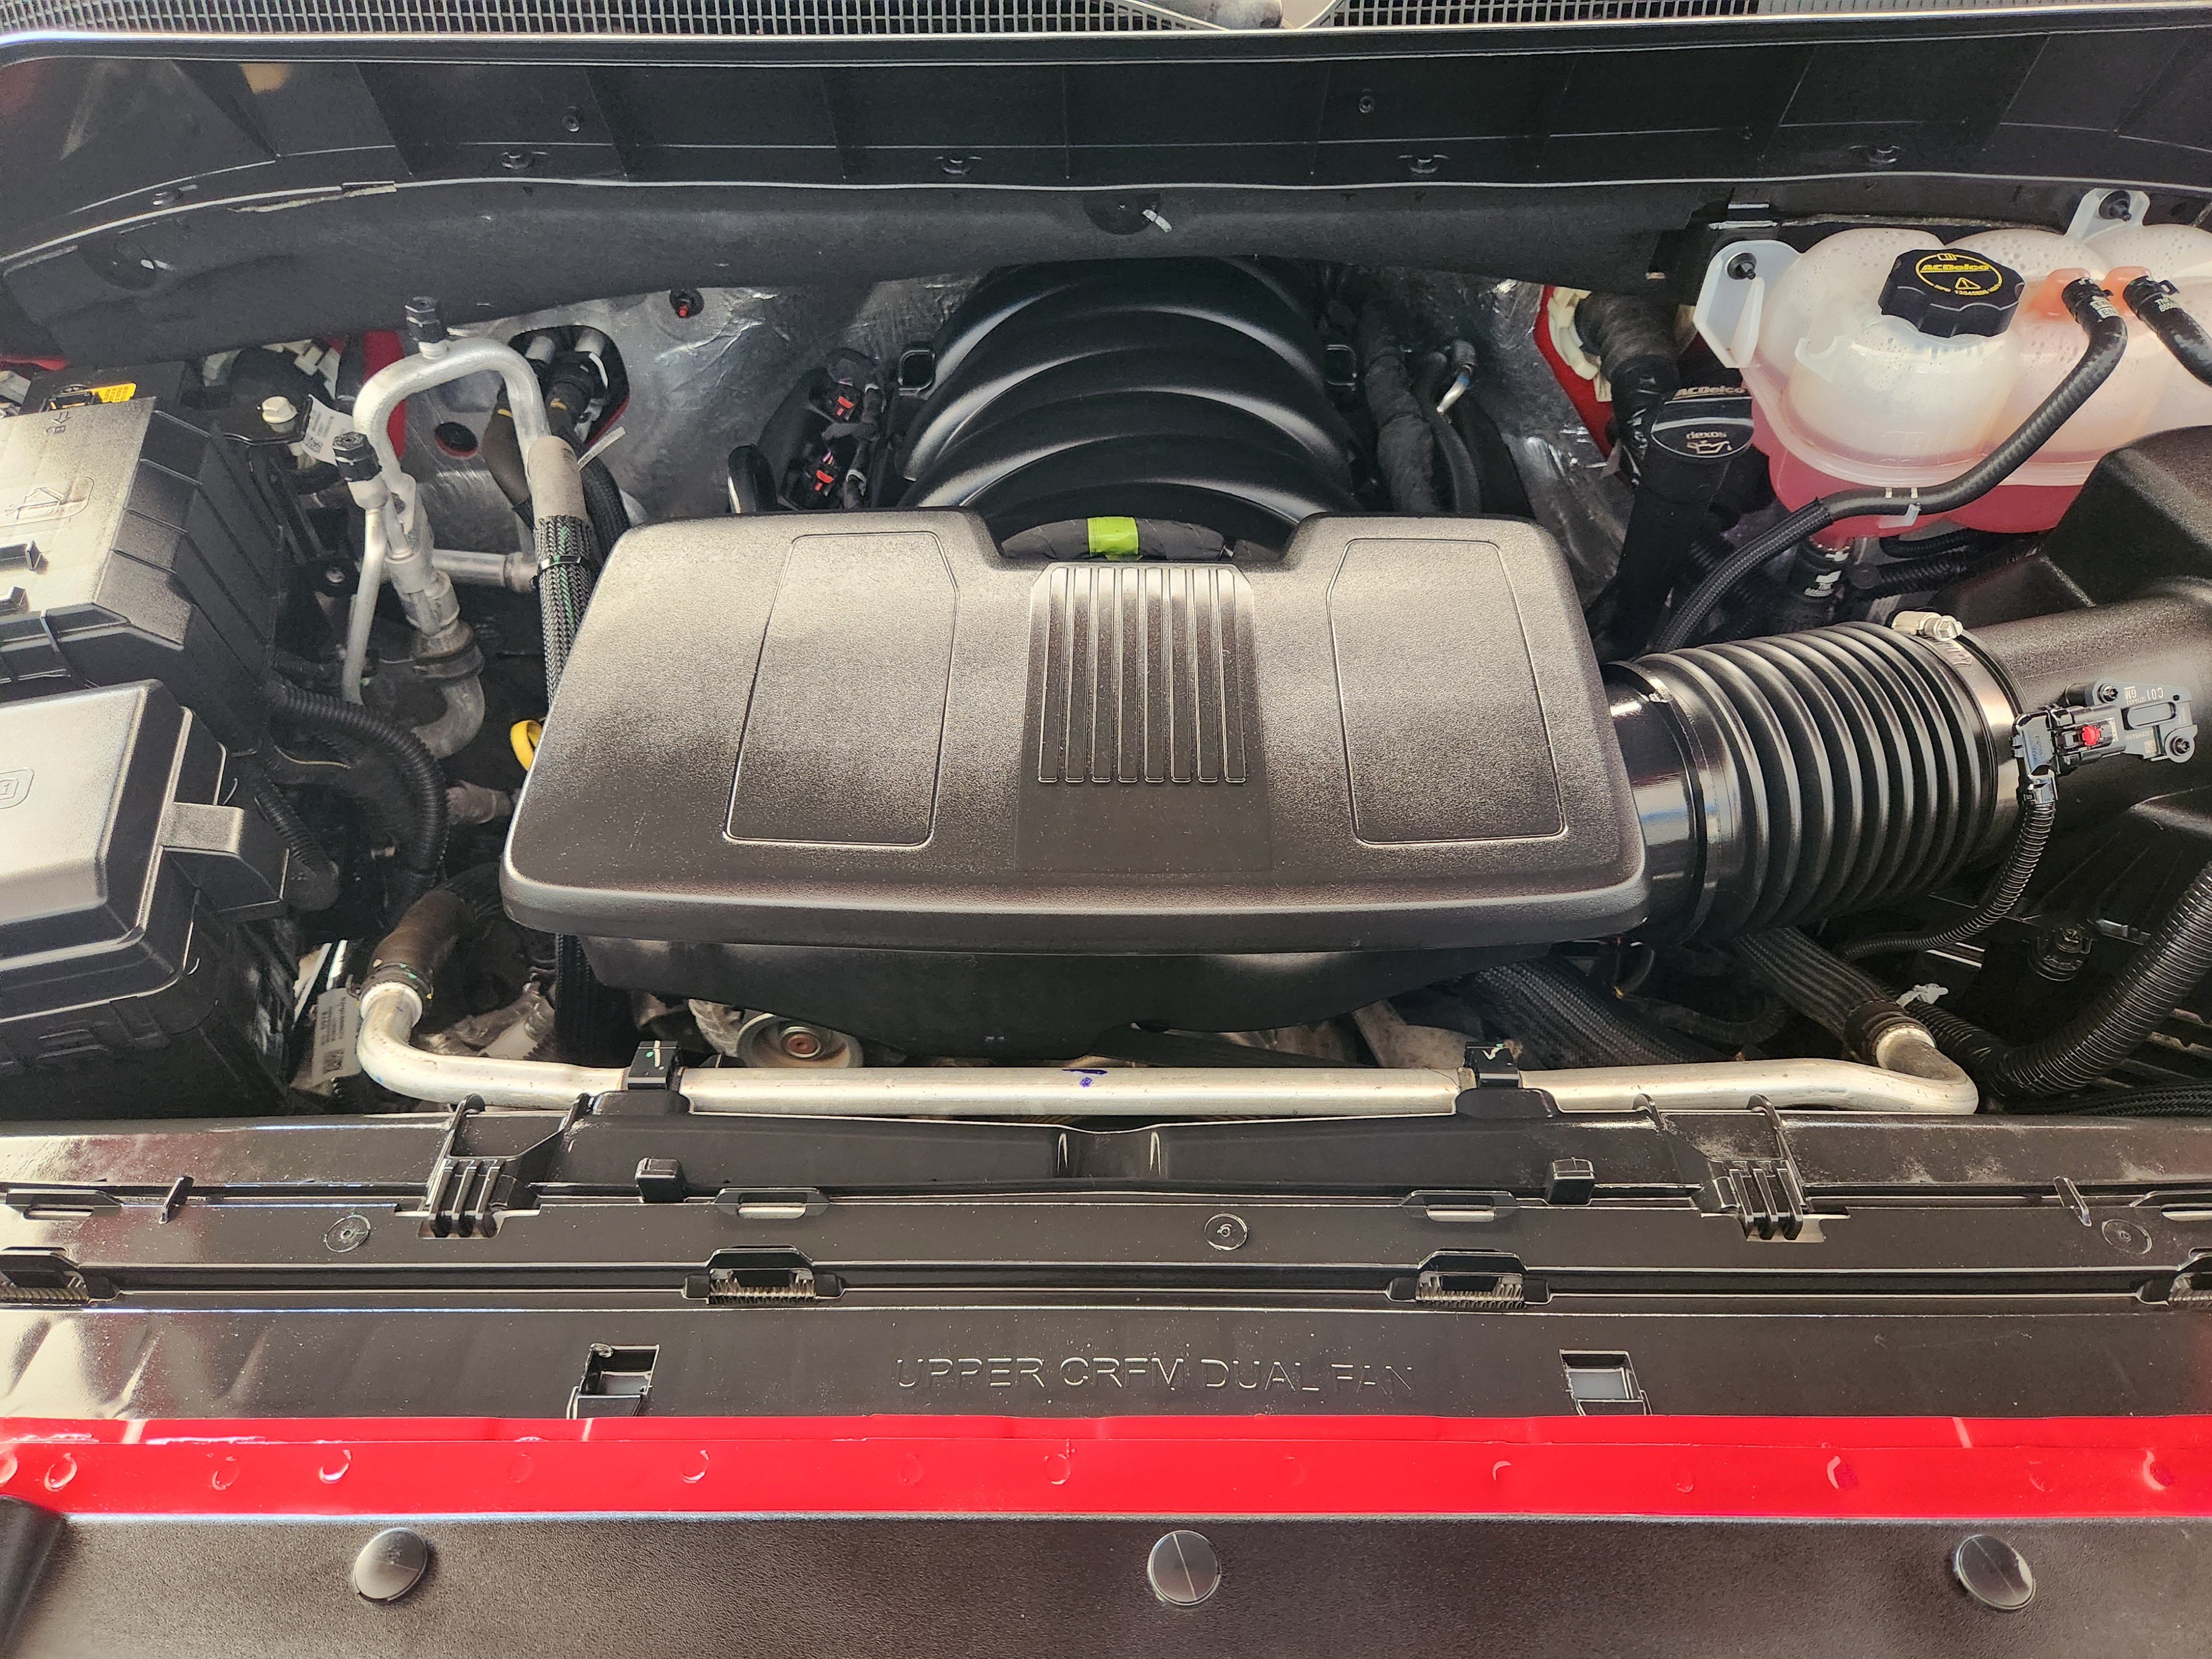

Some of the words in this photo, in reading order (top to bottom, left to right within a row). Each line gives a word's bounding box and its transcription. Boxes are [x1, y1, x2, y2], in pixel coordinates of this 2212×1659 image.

[1921, 263, 1990, 272] ACDelco
[1674, 385, 1746, 397] ACDelco
[2125, 689, 2137, 700] GM
[894, 1357, 1045, 1389] UPPER
[1060, 1357, 1185, 1391] CRFM
[1201, 1358, 1321, 1392] DUAL
[1331, 1363, 1415, 1396] FAN
